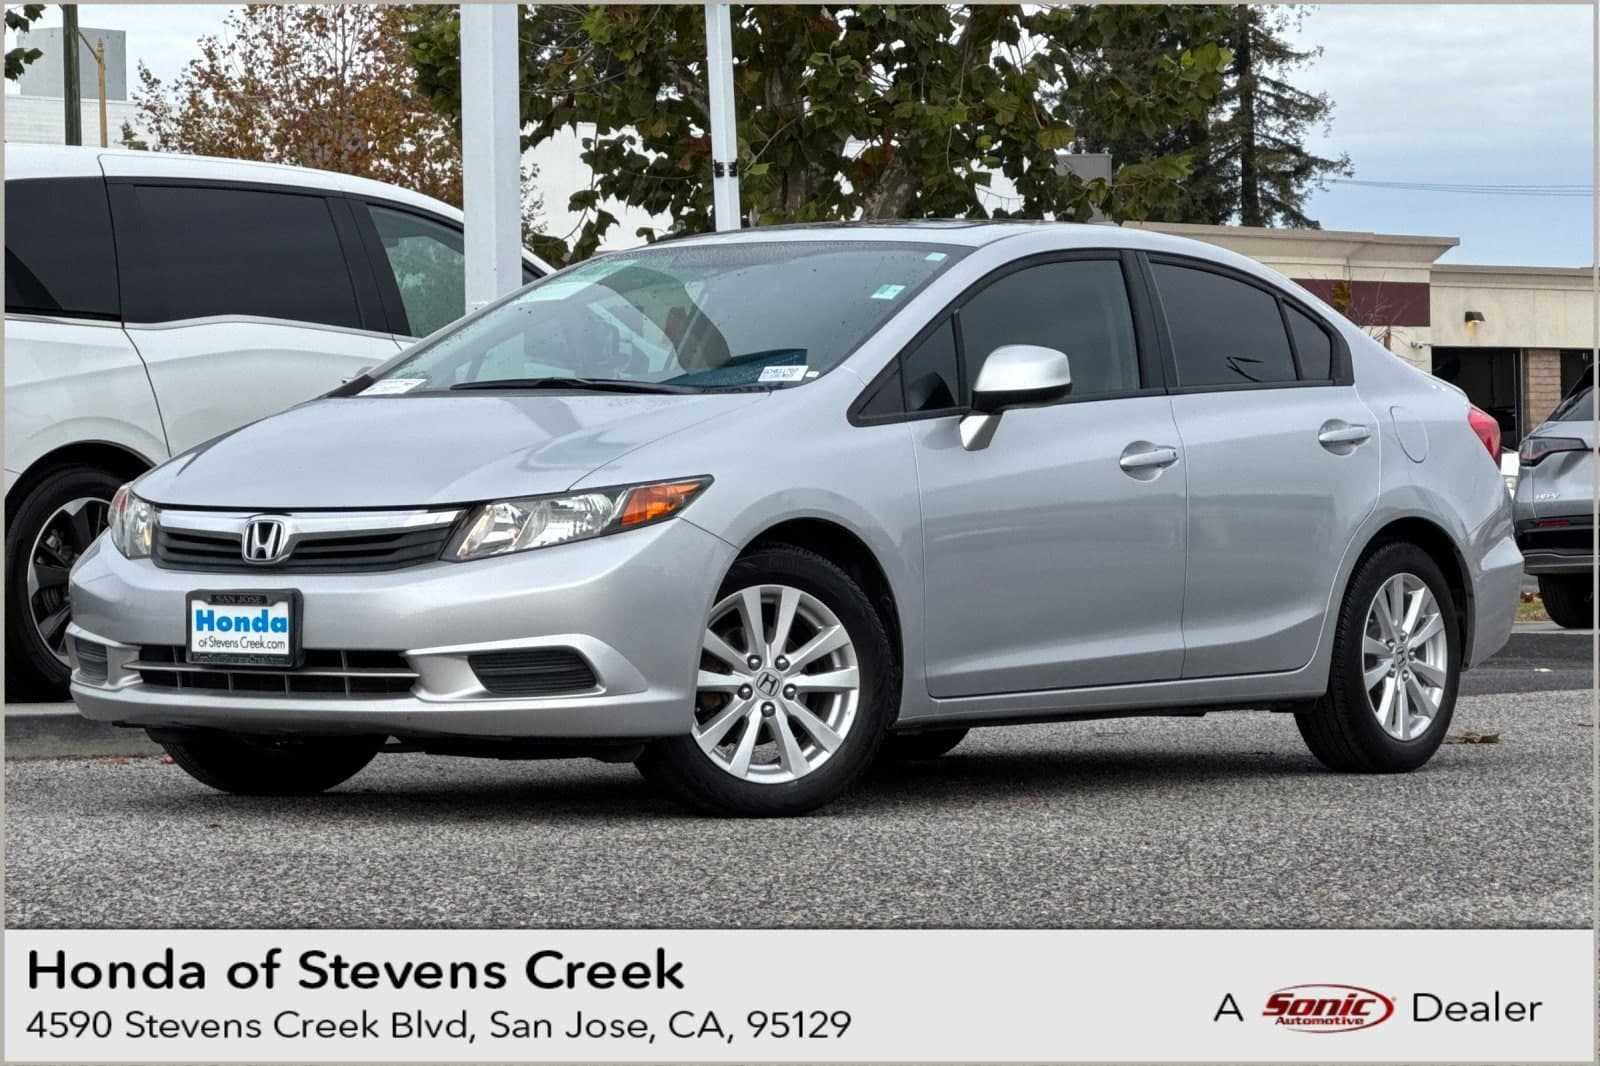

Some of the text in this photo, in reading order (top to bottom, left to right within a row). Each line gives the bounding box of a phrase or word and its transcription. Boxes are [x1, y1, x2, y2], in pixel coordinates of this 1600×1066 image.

[196, 609, 287, 632] Honda
[198, 635, 286, 649] of Stevens Creek.com
